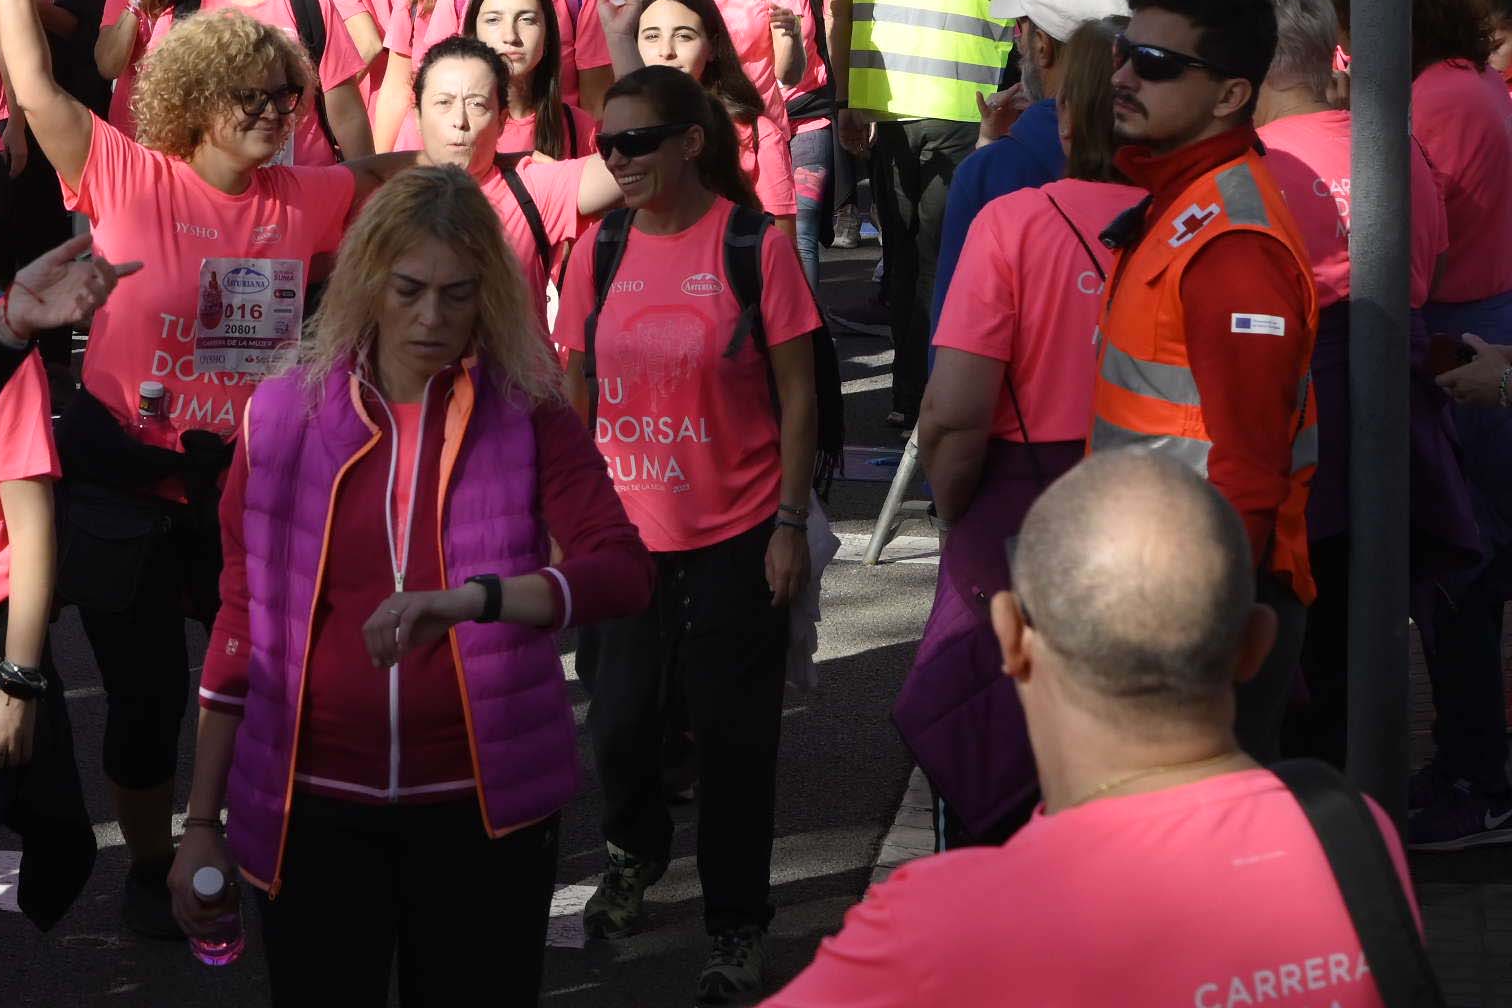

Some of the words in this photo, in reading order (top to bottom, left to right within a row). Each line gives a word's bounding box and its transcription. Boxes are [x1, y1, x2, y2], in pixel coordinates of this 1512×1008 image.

[160, 313, 199, 343] TU
[598, 376, 623, 404] U
[169, 392, 236, 426] UMA
[596, 415, 713, 444] DORSAL
